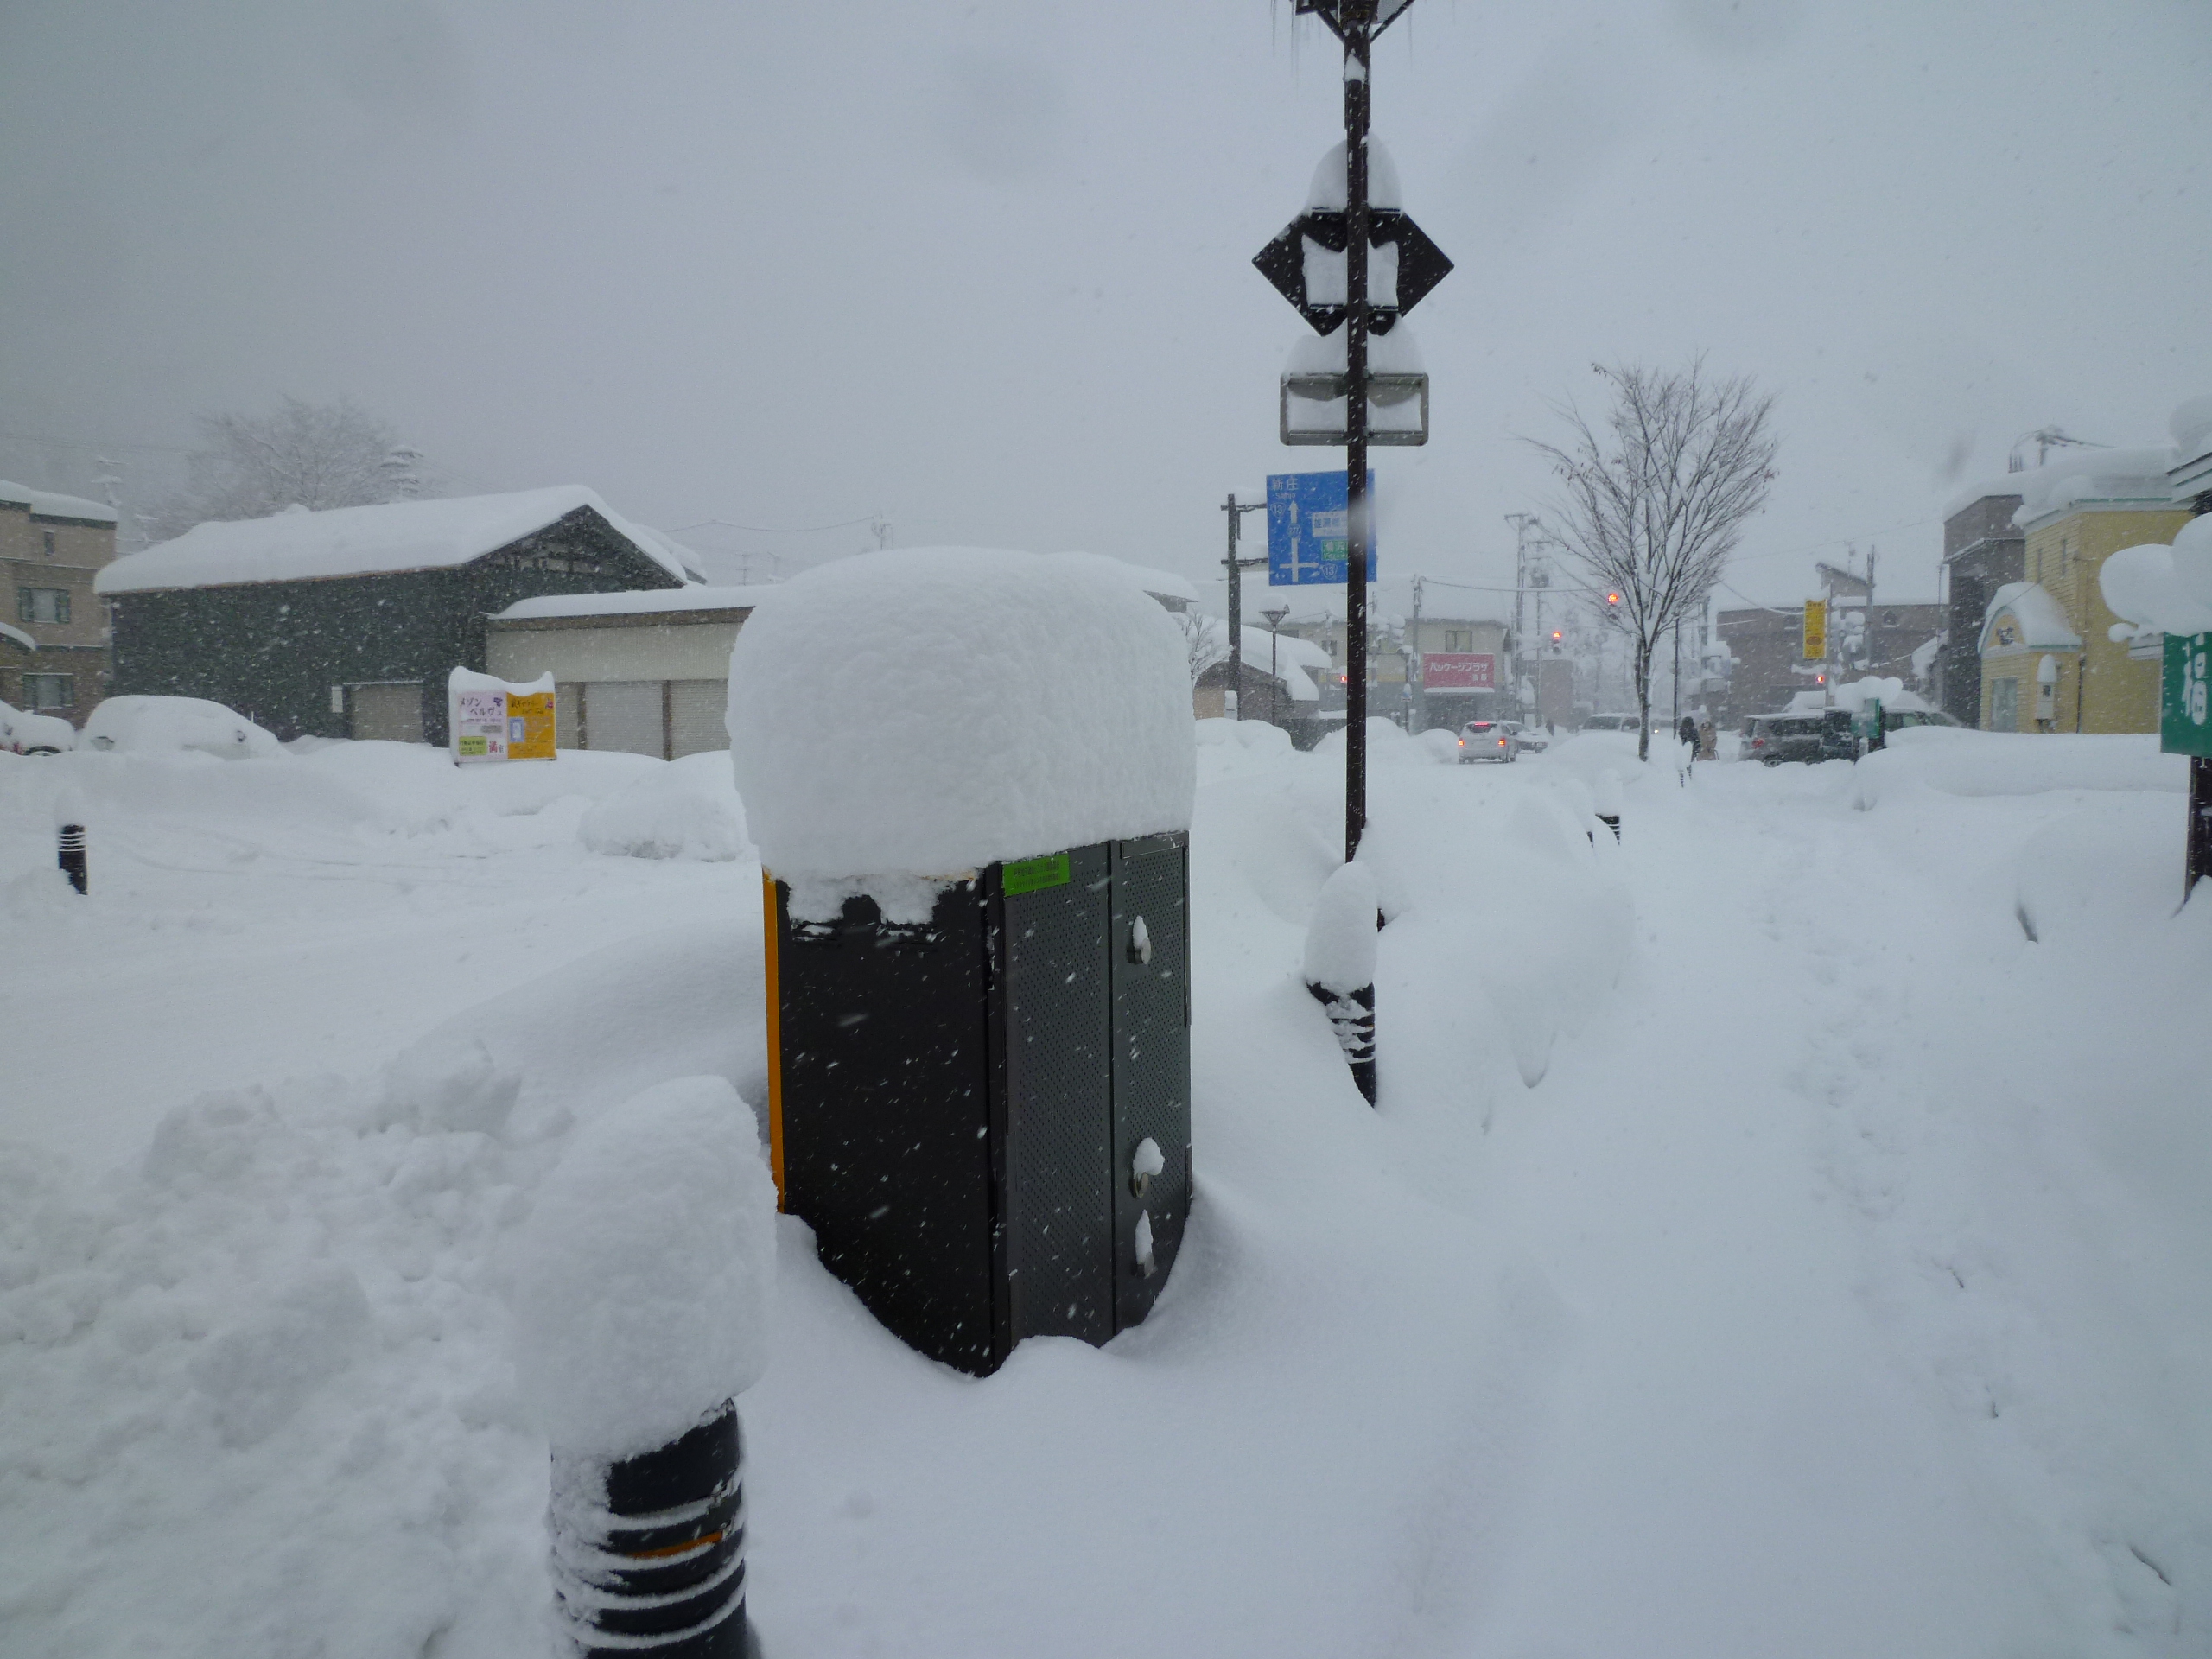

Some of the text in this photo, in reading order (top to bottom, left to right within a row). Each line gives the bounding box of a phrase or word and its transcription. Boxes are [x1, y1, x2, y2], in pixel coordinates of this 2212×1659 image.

[1272, 475, 1298, 491] 新庄
[1272, 504, 1283, 514] 13
[1325, 566, 1335, 576] 13
[460, 697, 482, 708] メゾン
